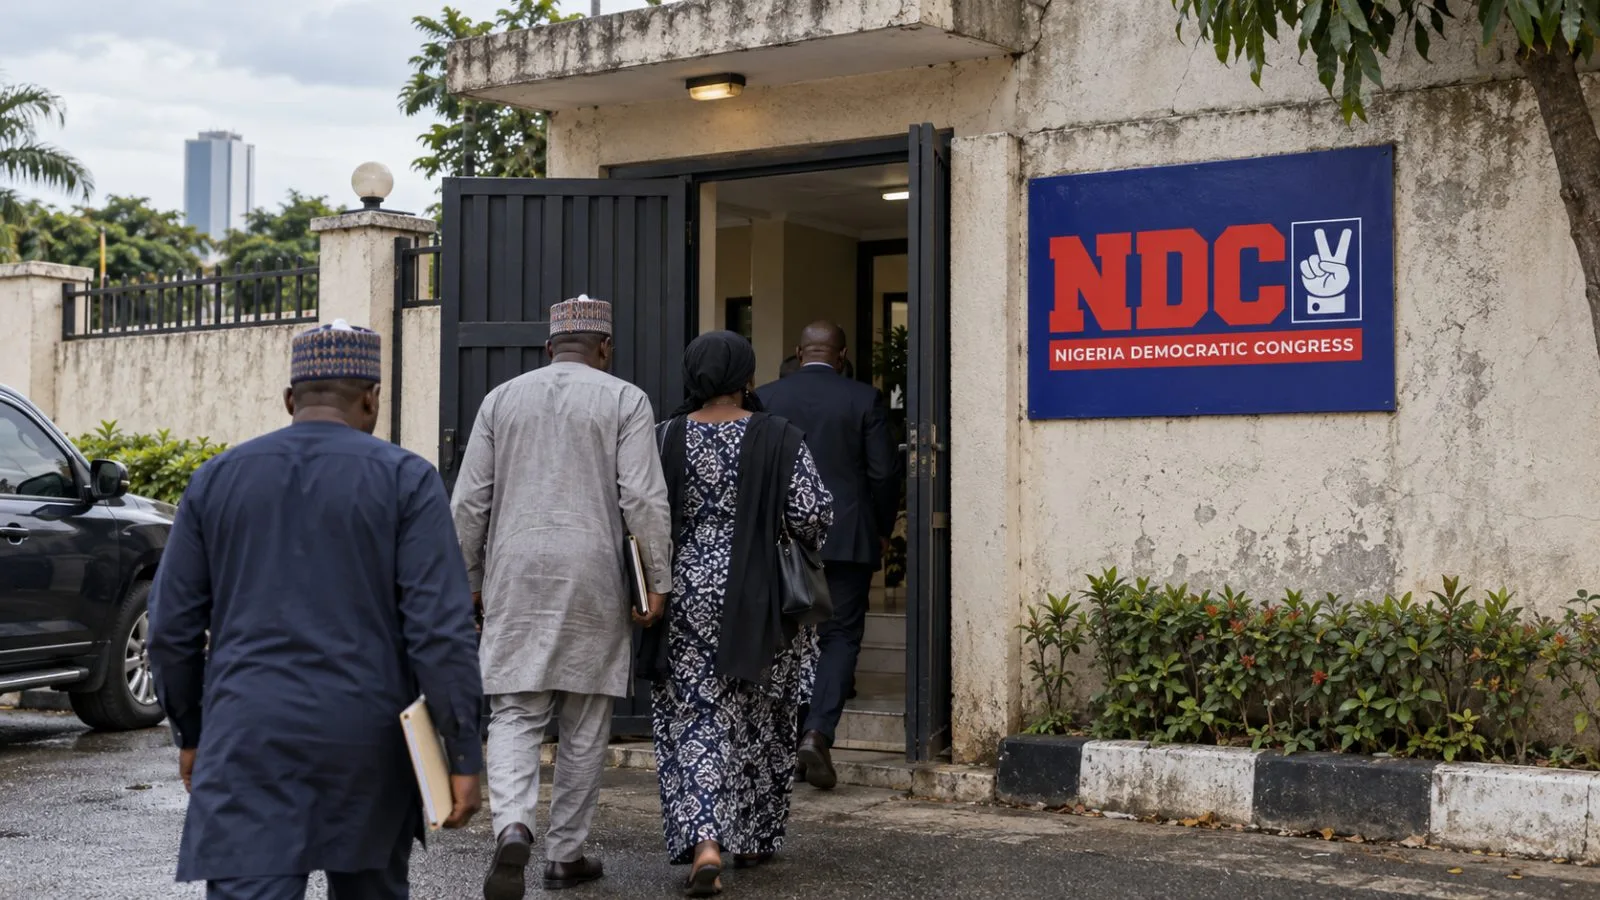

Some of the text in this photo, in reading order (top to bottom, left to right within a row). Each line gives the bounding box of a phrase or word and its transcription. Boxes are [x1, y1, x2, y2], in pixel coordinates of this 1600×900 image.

[1049, 223, 1285, 333] NDC
[1055, 338, 1354, 362] NIGERIA DEMOCRATIC CONGRESS
